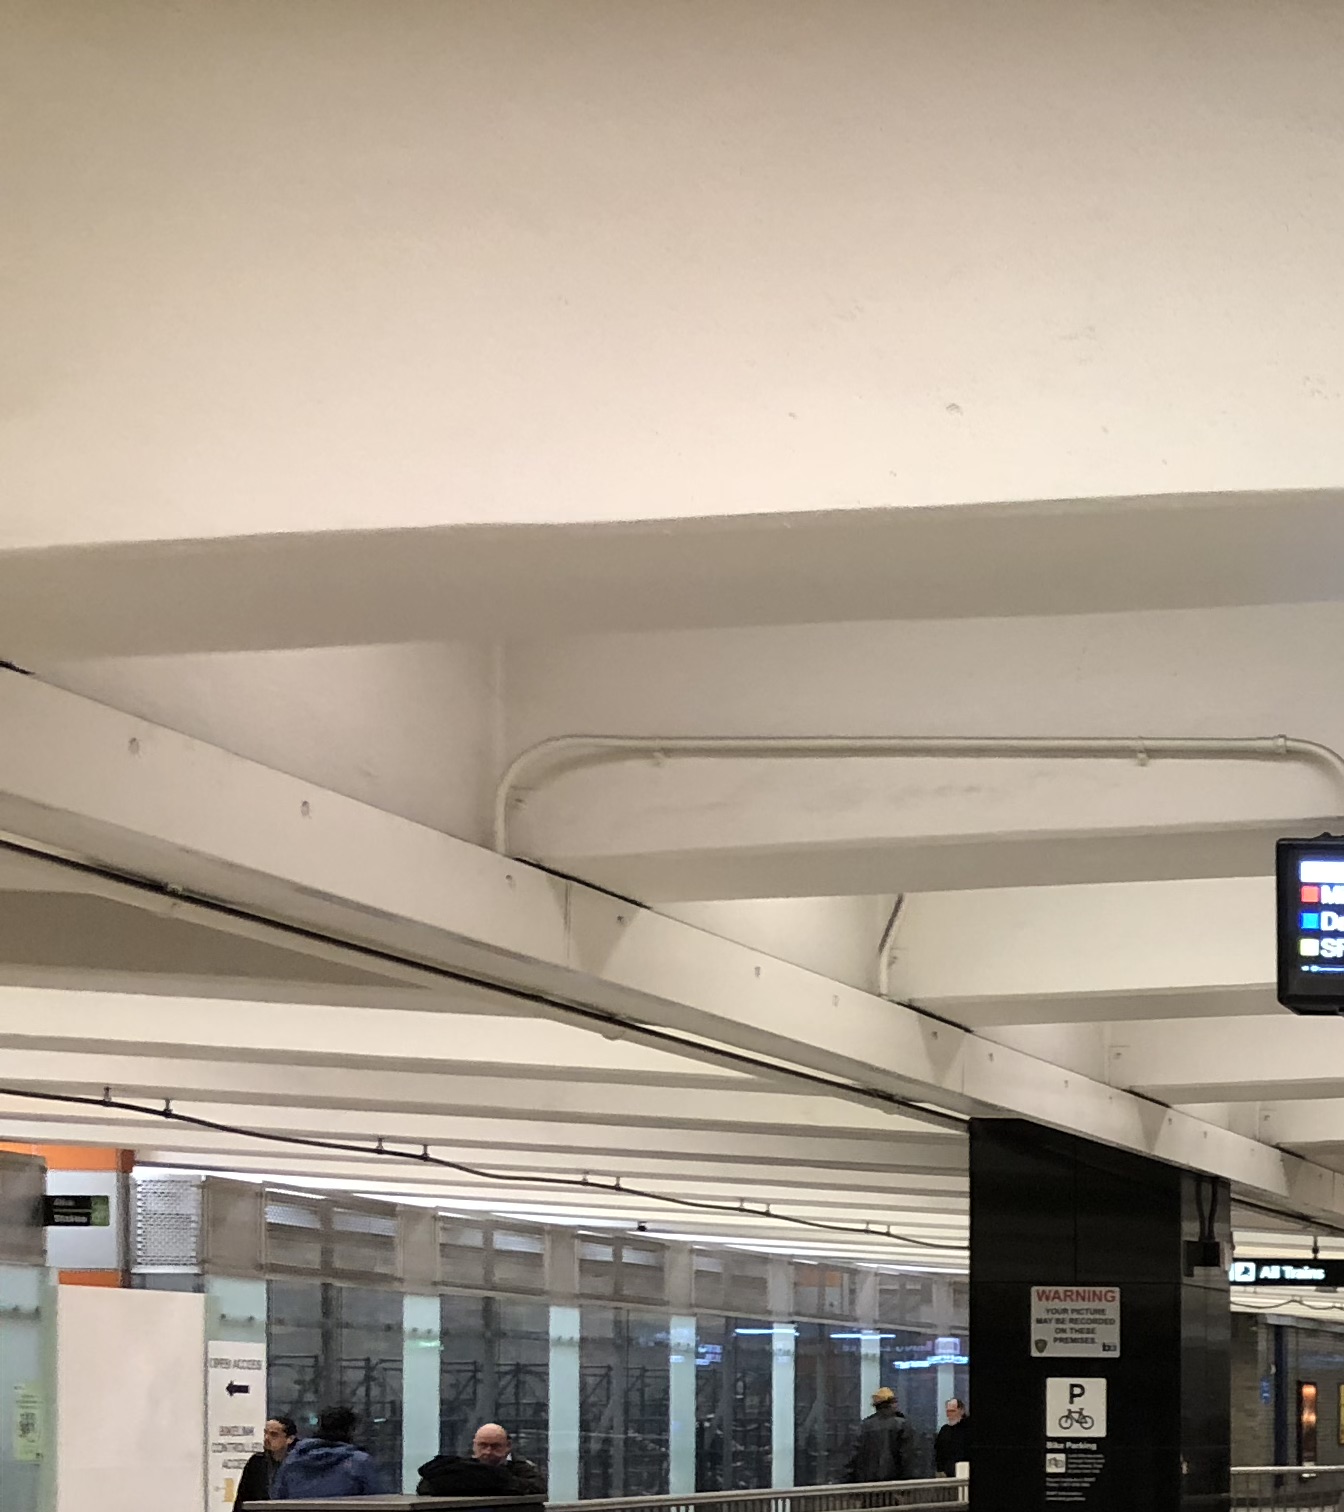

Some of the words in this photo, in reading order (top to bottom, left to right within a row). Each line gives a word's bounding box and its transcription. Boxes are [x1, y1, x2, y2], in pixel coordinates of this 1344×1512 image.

[1259, 1265, 1280, 1279] All
[1281, 1265, 1326, 1280] Trains
[1036, 1289, 1116, 1303] WARNING
[1046, 1307, 1069, 1315] YOUR
[1070, 1308, 1107, 1316] PICTURE
[1035, 1317, 1053, 1325] MAY
[1055, 1317, 1066, 1325] BE
[1068, 1317, 1116, 1326] RECORDED
[1054, 1327, 1067, 1335] ON
[1069, 1327, 1097, 1335] THESE
[1069, 1383, 1085, 1405] P
[1045, 1441, 1065, 1450] Bike
[1066, 1441, 1097, 1451] Parking
